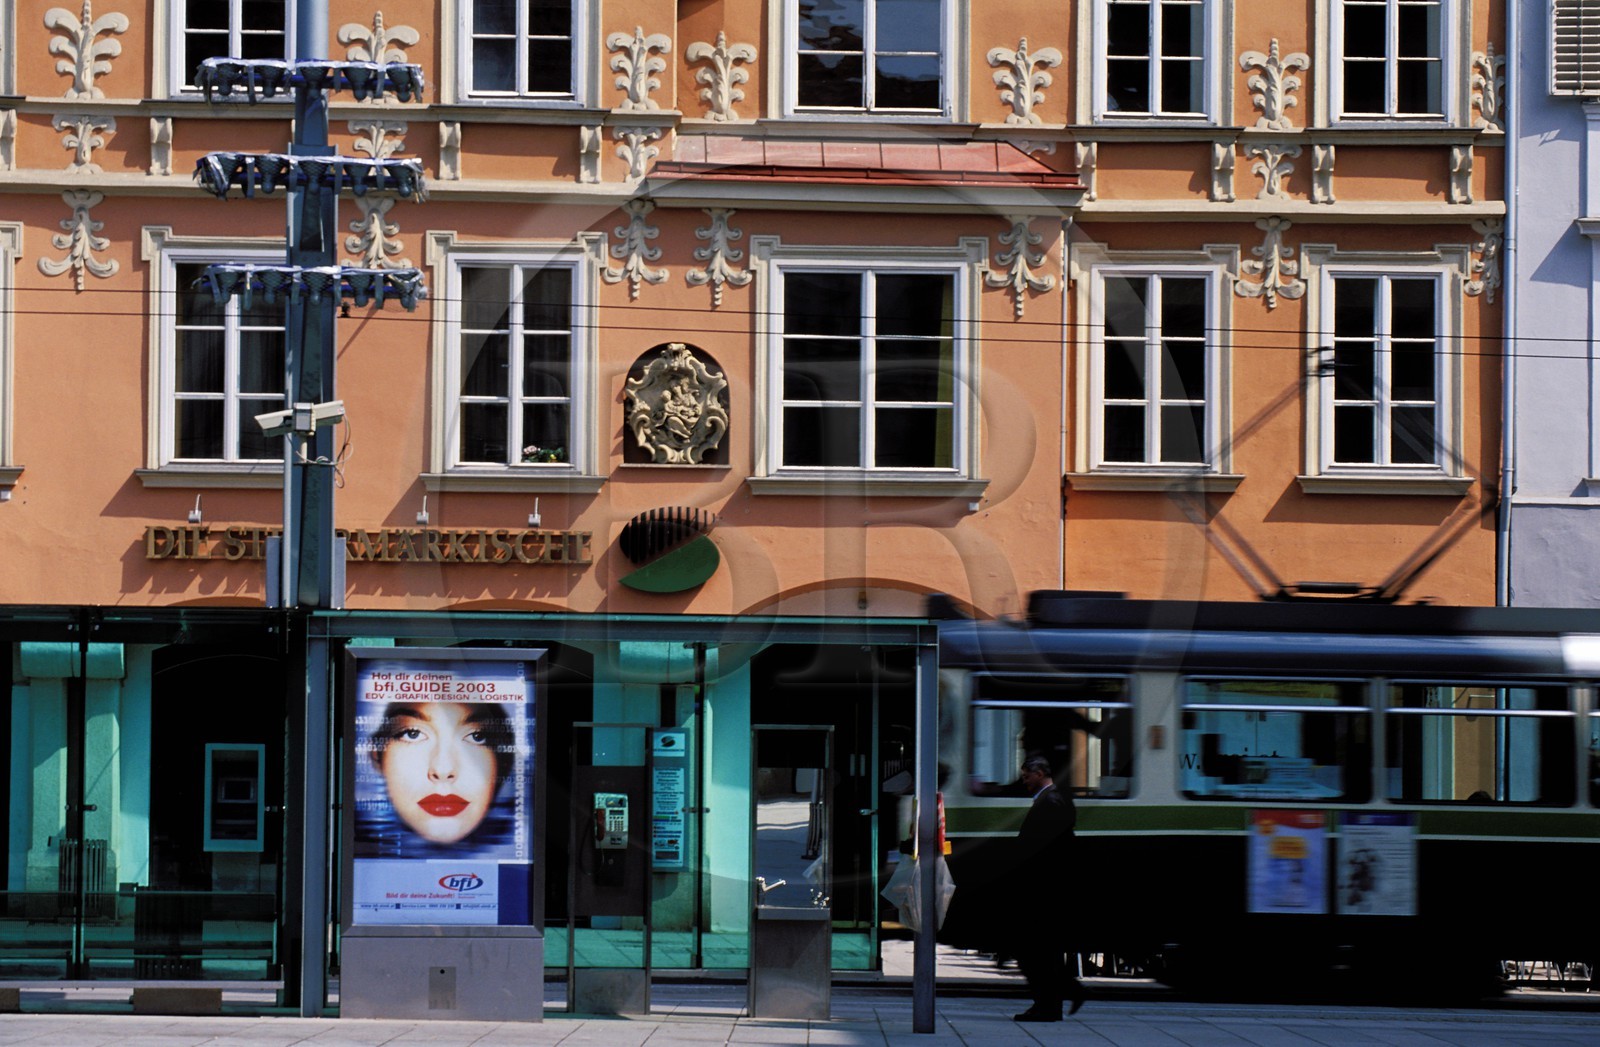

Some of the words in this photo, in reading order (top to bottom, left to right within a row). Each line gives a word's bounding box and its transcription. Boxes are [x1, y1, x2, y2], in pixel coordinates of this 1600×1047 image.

[144, 525, 212, 560] DIE
[224, 526, 594, 565] STRMÄRKISCHE
[372, 672, 391, 680] Hol
[395, 672, 410, 680] dir
[414, 673, 453, 681] deinen
[374, 682, 451, 693] bfi.GUIDE
[456, 683, 496, 693] 2003
[479, 694, 524, 702] LOGISTIK
[449, 879, 472, 892] bfi
